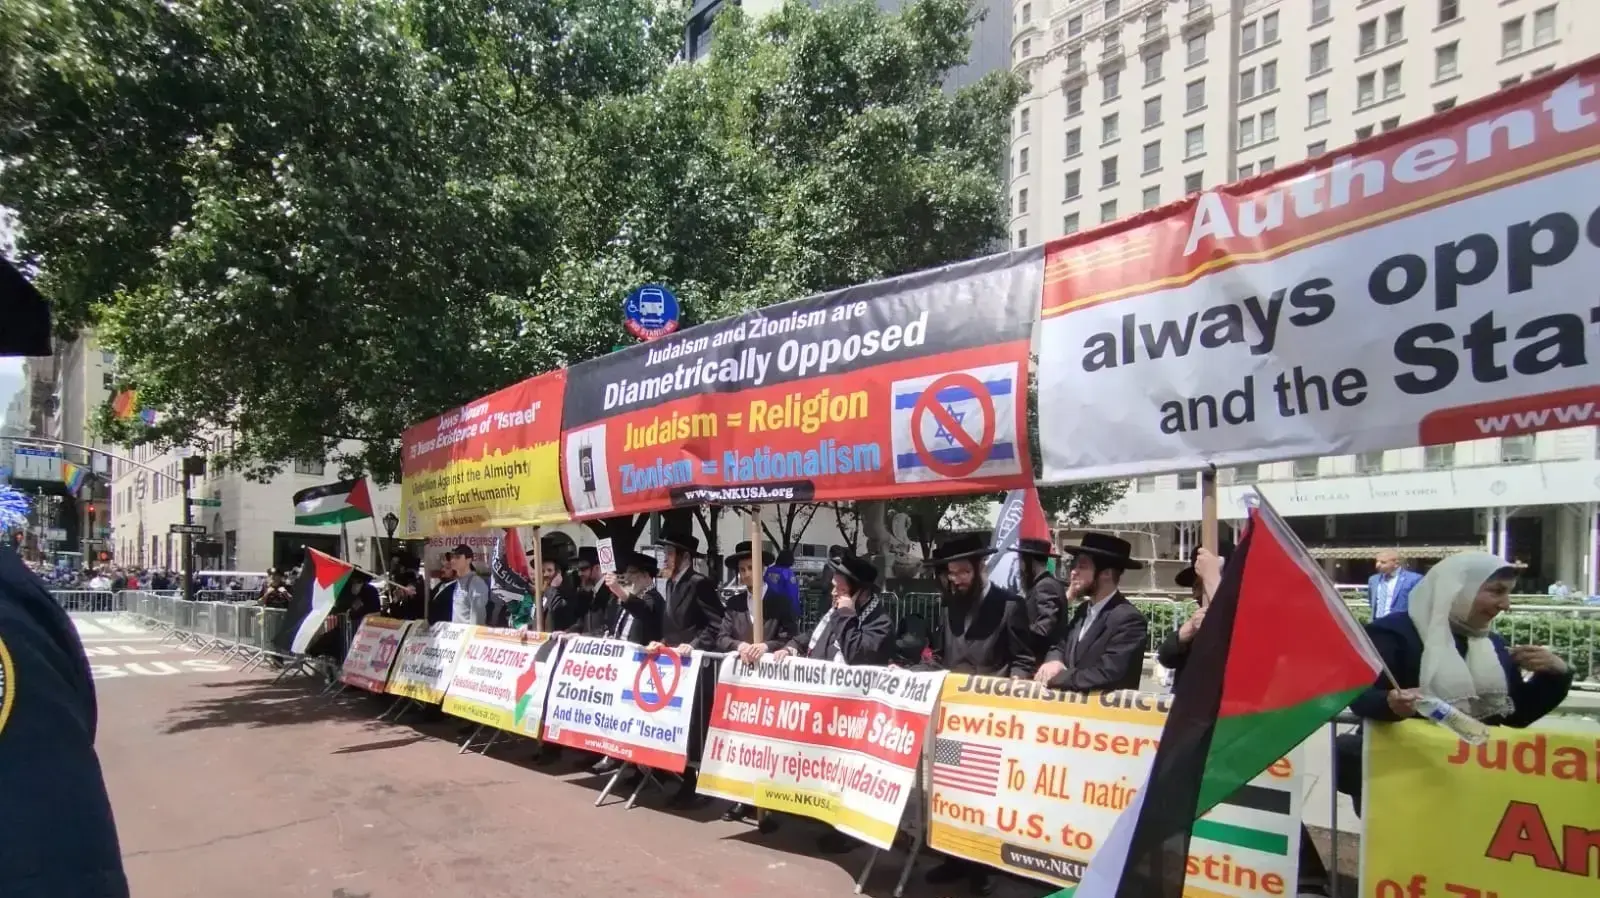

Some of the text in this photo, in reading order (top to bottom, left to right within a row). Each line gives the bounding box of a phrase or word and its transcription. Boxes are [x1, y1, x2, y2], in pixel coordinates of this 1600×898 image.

[1183, 74, 1599, 256] Authent
[1082, 212, 1600, 372] always opp
[645, 300, 868, 367] Judaism and Zionism are
[603, 310, 929, 411] Diametrically Opposed
[1159, 304, 1600, 435] and the Sta
[480, 415, 492, 434] of
[494, 400, 542, 430] "Israel"
[622, 410, 718, 452] Judaism
[748, 388, 869, 434] Religion
[466, 469, 481, 482] the
[618, 457, 693, 495] Zionism
[723, 438, 881, 482] Nationalism
[457, 490, 470, 504] for
[471, 482, 521, 501] Humanity
[684, 485, 795, 500] www.NKUSA.org
[466, 644, 529, 668] ALL PALESTINE
[568, 638, 625, 658] Judaism
[495, 668, 503, 680] to
[561, 658, 619, 681] Rejects
[758, 658, 790, 681] world
[794, 662, 826, 684] must
[830, 668, 900, 696] recognize
[900, 673, 933, 703] that
[957, 674, 1089, 705] Judaism
[556, 681, 614, 706] Zionism
[553, 704, 683, 743] And the State of "Israel"
[722, 692, 916, 755] Israel is NOT a Jew State
[936, 706, 1025, 741] Jewish
[710, 735, 725, 761] It
[726, 740, 736, 764] is
[738, 744, 779, 779] totally
[782, 752, 841, 783] rejected
[1007, 758, 1025, 792] To
[1034, 763, 1070, 800] ALL
[933, 792, 1093, 850] from U.S. to
